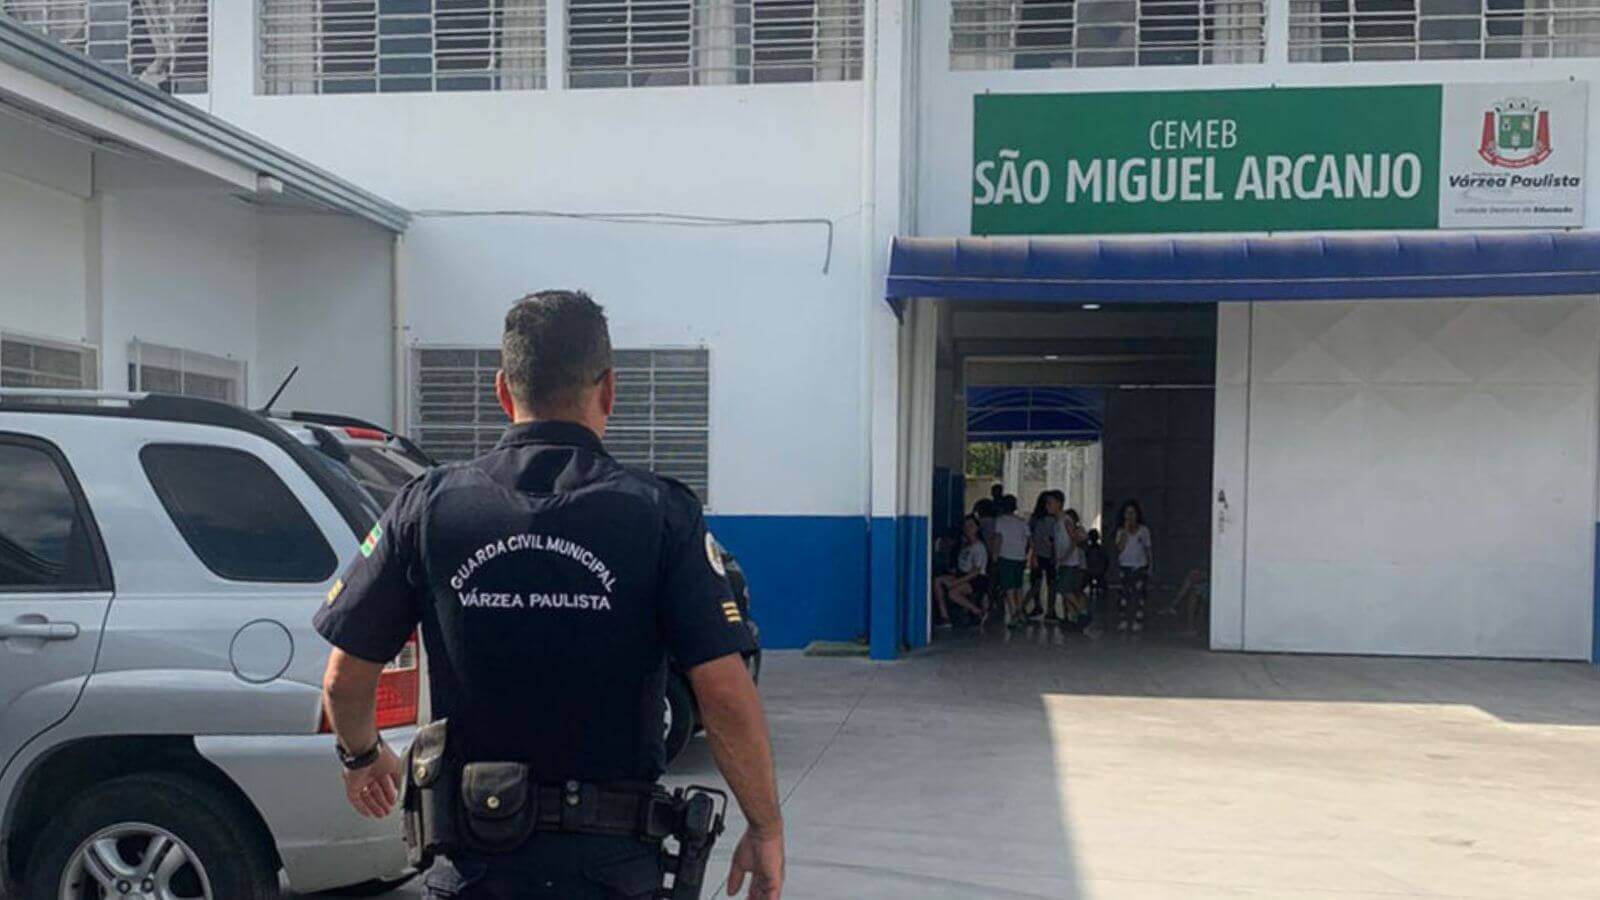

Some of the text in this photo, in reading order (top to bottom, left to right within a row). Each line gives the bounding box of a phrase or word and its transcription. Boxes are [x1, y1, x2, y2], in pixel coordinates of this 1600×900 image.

[1149, 119, 1238, 150] CEMEB
[974, 149, 1422, 205] SÃO MIGUEL ARCANJO
[1449, 175, 1506, 188] Várzea
[1510, 173, 1580, 188] Paulista
[450, 534, 617, 592] GUARDA CIVIL MUNICIPAL
[458, 587, 612, 610] VÁRZEA PAULISTA
